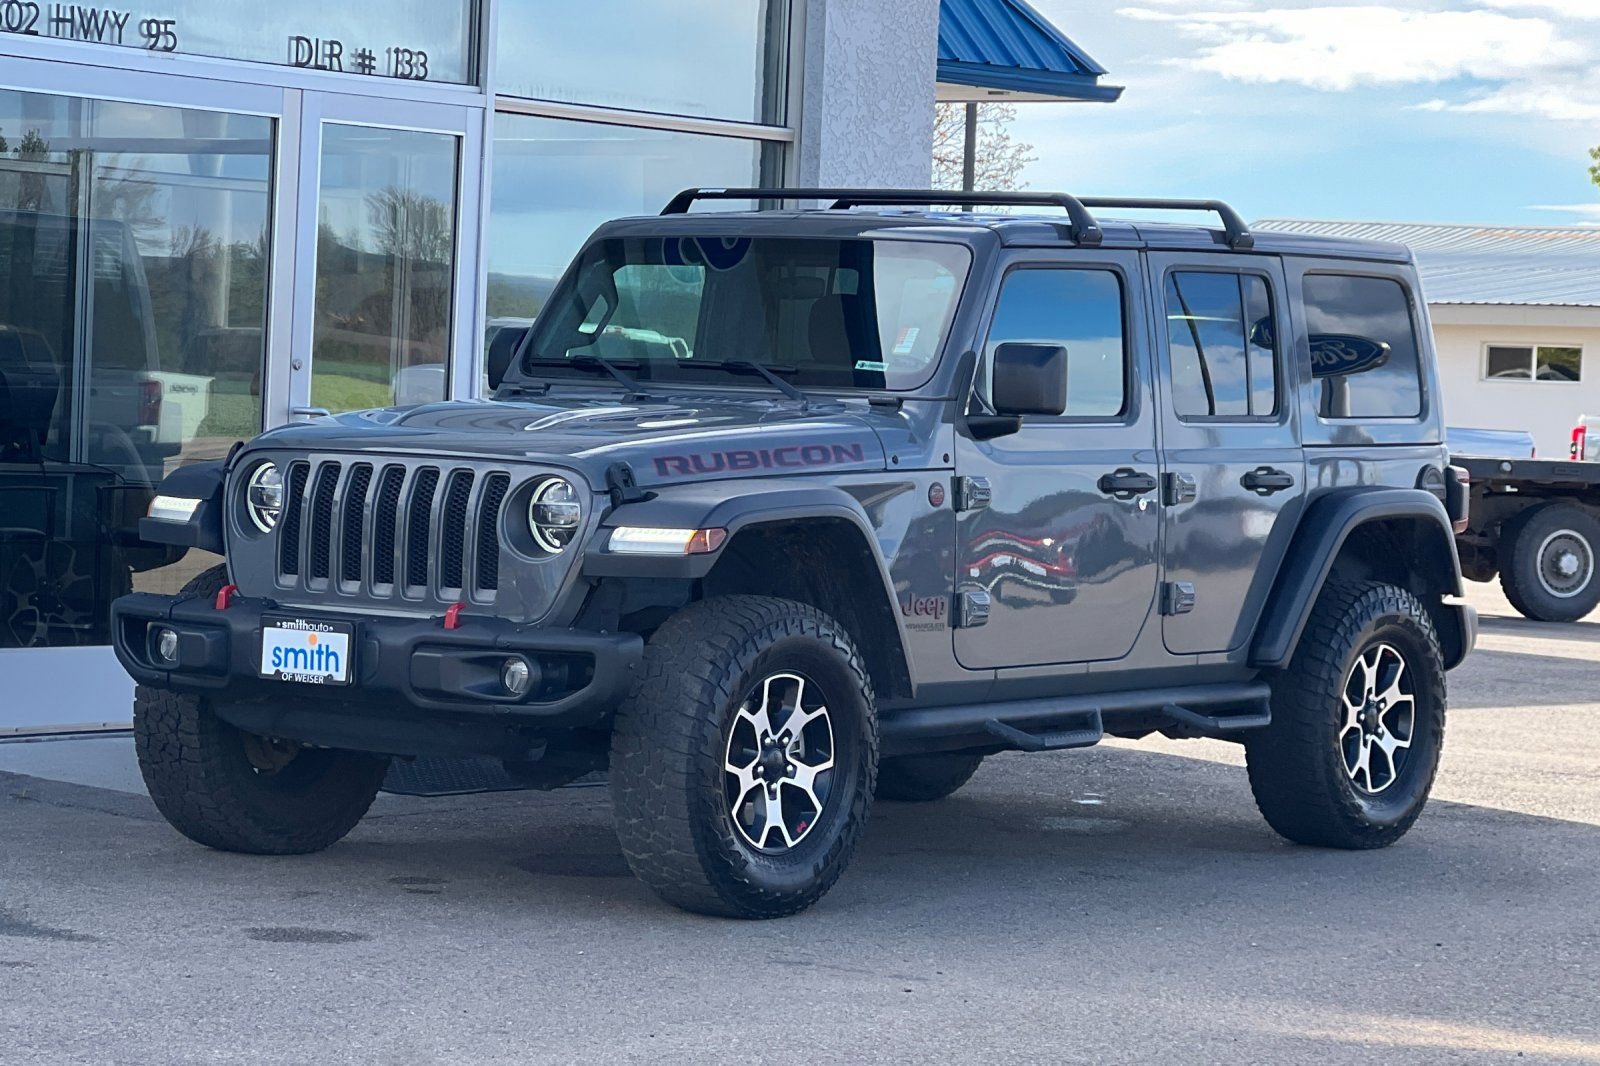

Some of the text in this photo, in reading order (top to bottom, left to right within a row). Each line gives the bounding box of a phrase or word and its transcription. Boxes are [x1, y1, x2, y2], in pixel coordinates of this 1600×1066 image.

[0, 0, 177, 52] 02 HWY 95
[295, 36, 428, 80] DLR # 133
[653, 443, 865, 476] RUBICON
[902, 592, 944, 619] Jeep
[272, 634, 339, 672] smith
[281, 672, 324, 684] OF WEISER
